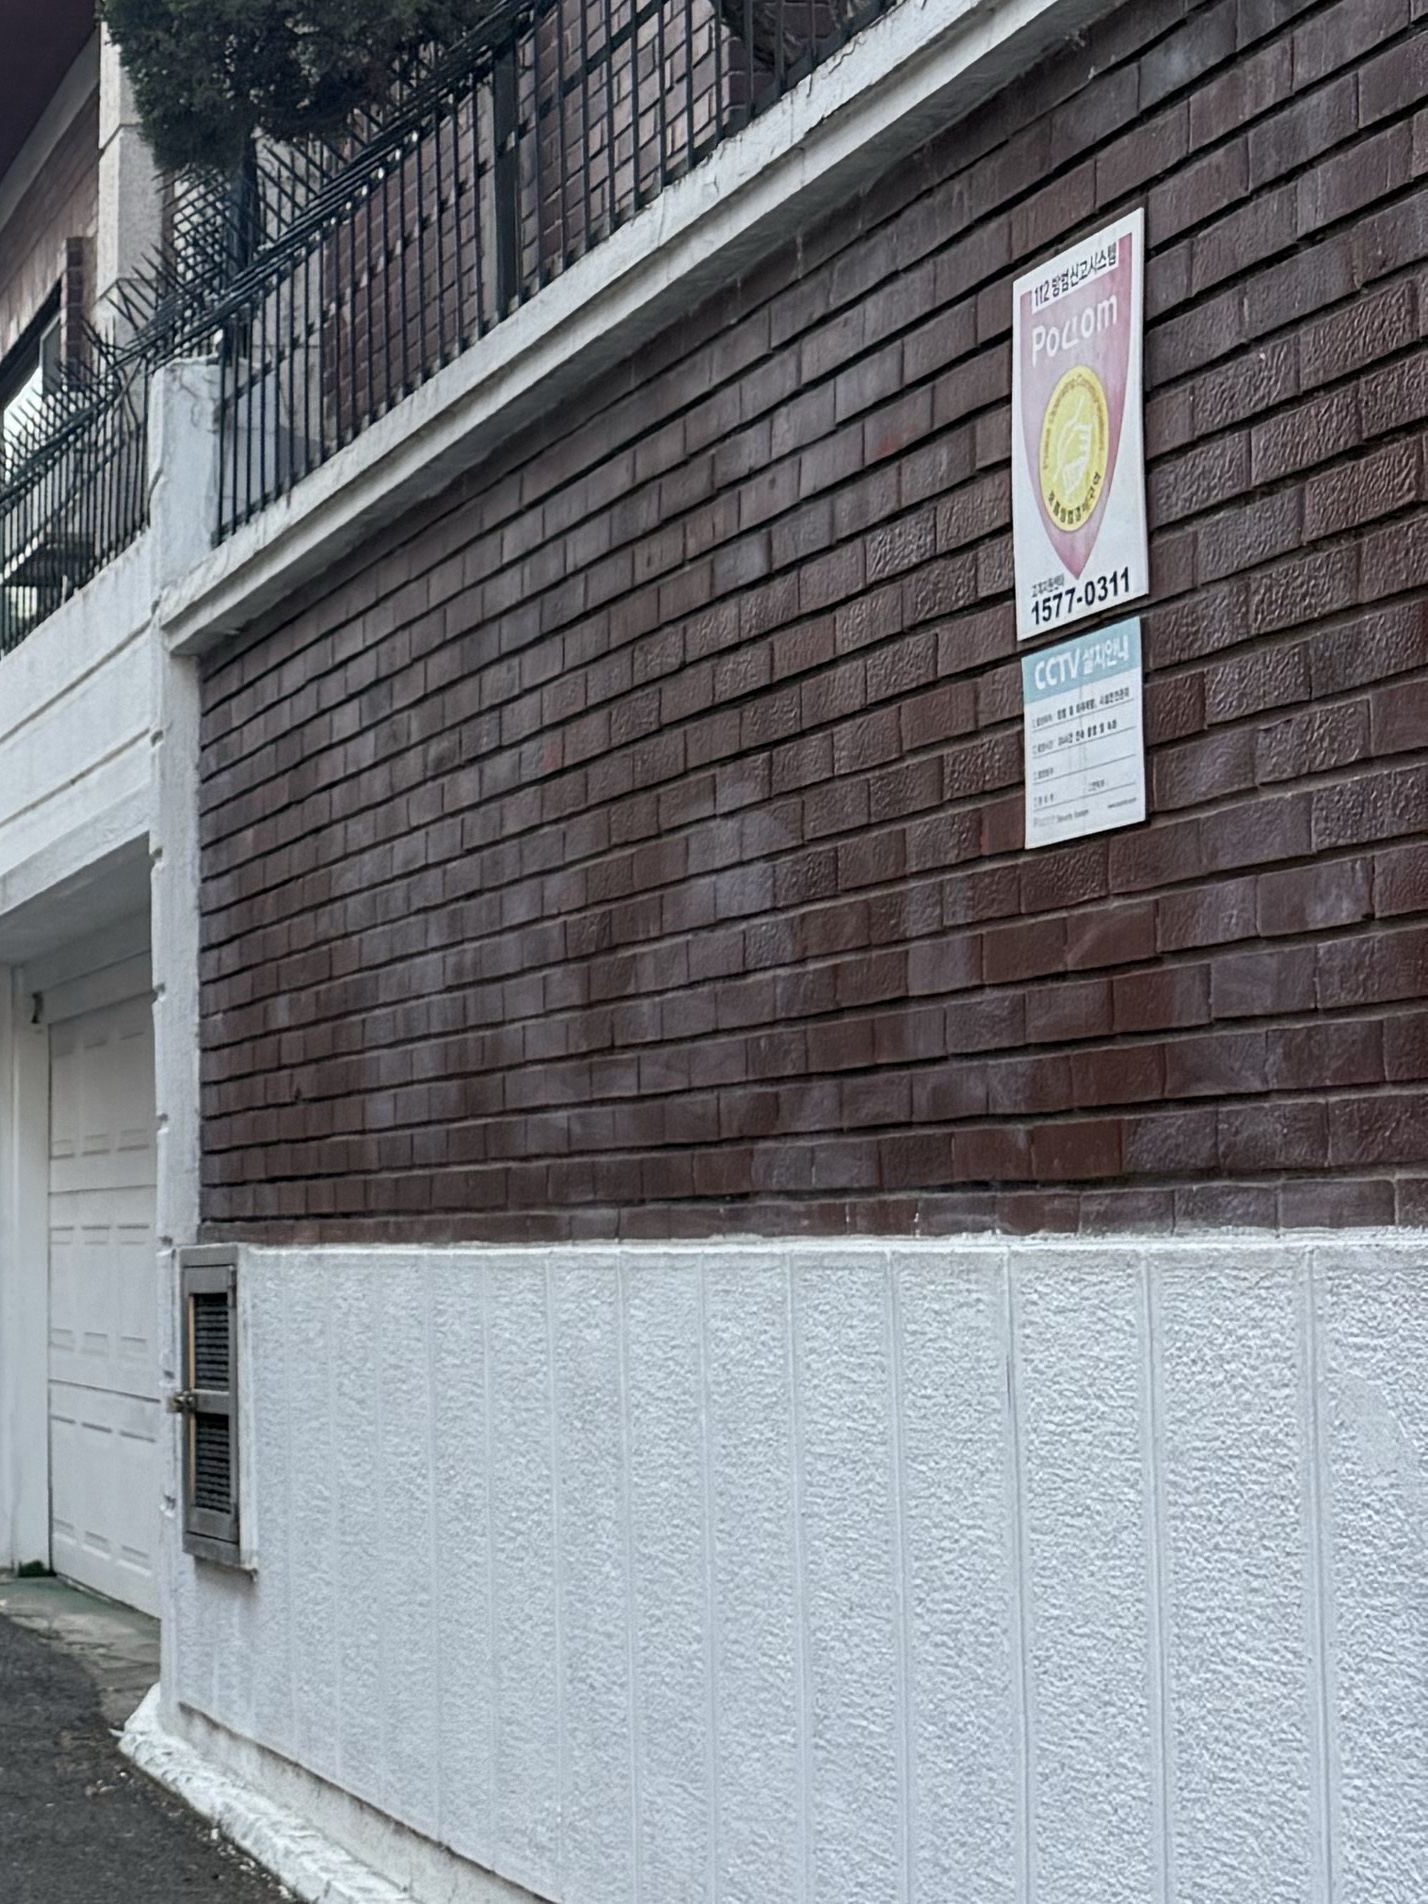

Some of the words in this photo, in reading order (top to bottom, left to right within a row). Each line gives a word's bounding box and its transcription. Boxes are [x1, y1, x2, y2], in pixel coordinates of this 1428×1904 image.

[1031, 566, 1129, 626] 1577-0311
[1034, 647, 1080, 690] CCTV
[1082, 634, 1129, 675] 설치안내
